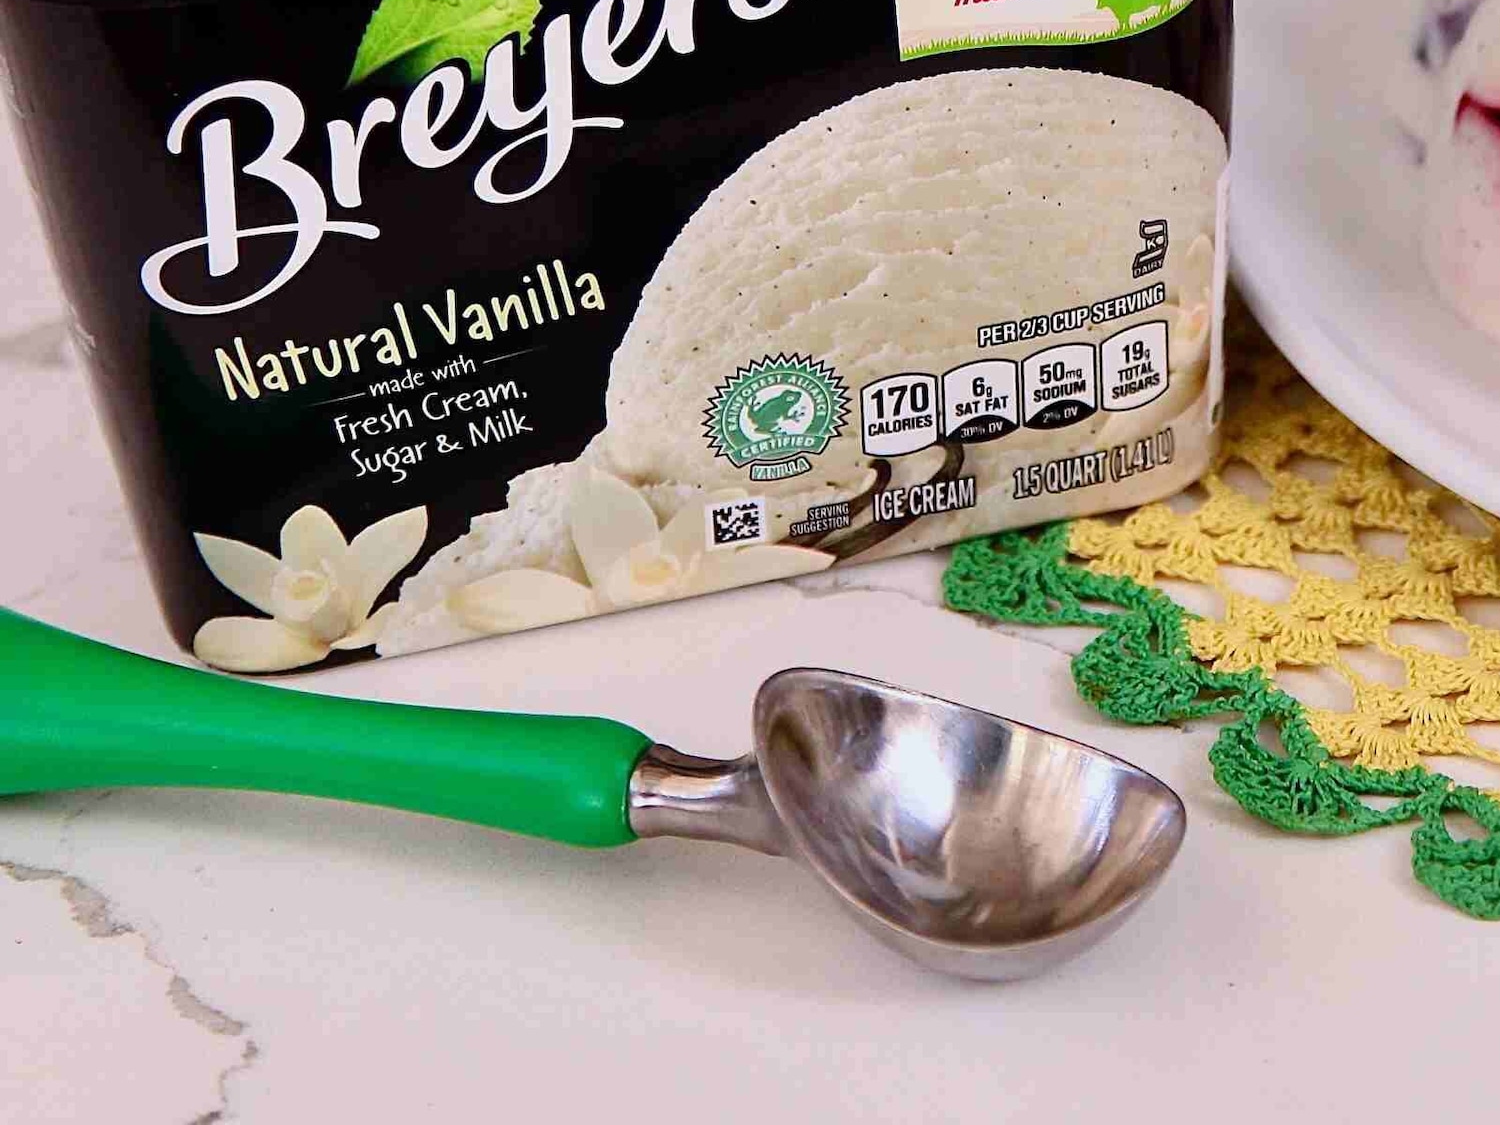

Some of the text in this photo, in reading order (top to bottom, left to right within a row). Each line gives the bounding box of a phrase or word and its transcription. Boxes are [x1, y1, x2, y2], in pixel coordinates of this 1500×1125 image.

[1134, 259, 1163, 277] DAIRY
[979, 282, 1165, 347] PER 2/3 CUP SERVING
[214, 259, 606, 401] Natural Vanilla
[1122, 340, 1151, 364] 19g
[369, 355, 476, 397] made with
[1039, 361, 1083, 384] 50mg
[1117, 361, 1155, 382] TOTAL
[972, 377, 993, 398] 6g
[1033, 379, 1087, 402] SODIUM
[1112, 373, 1160, 399] SUGARS
[334, 380, 528, 443] Fresh Cream,
[728, 375, 827, 432] RAINFOREST ALLIANCE
[870, 382, 930, 419] 170
[955, 395, 1009, 416] SAT FAT
[1063, 406, 1079, 419] DV
[868, 415, 933, 437] CALORIES
[988, 421, 1004, 434] DV
[351, 407, 534, 484] Sugar & Milk
[740, 436, 815, 458] CERTIFIED
[751, 458, 811, 479] VANILLA
[1013, 467, 1044, 499] 1.5
[1046, 451, 1107, 494] QUART
[1109, 433, 1153, 484] (1.41
[874, 477, 976, 521] ICE CREAM
[807, 503, 850, 521] SERVING
[789, 515, 851, 537] SUGGESTION
